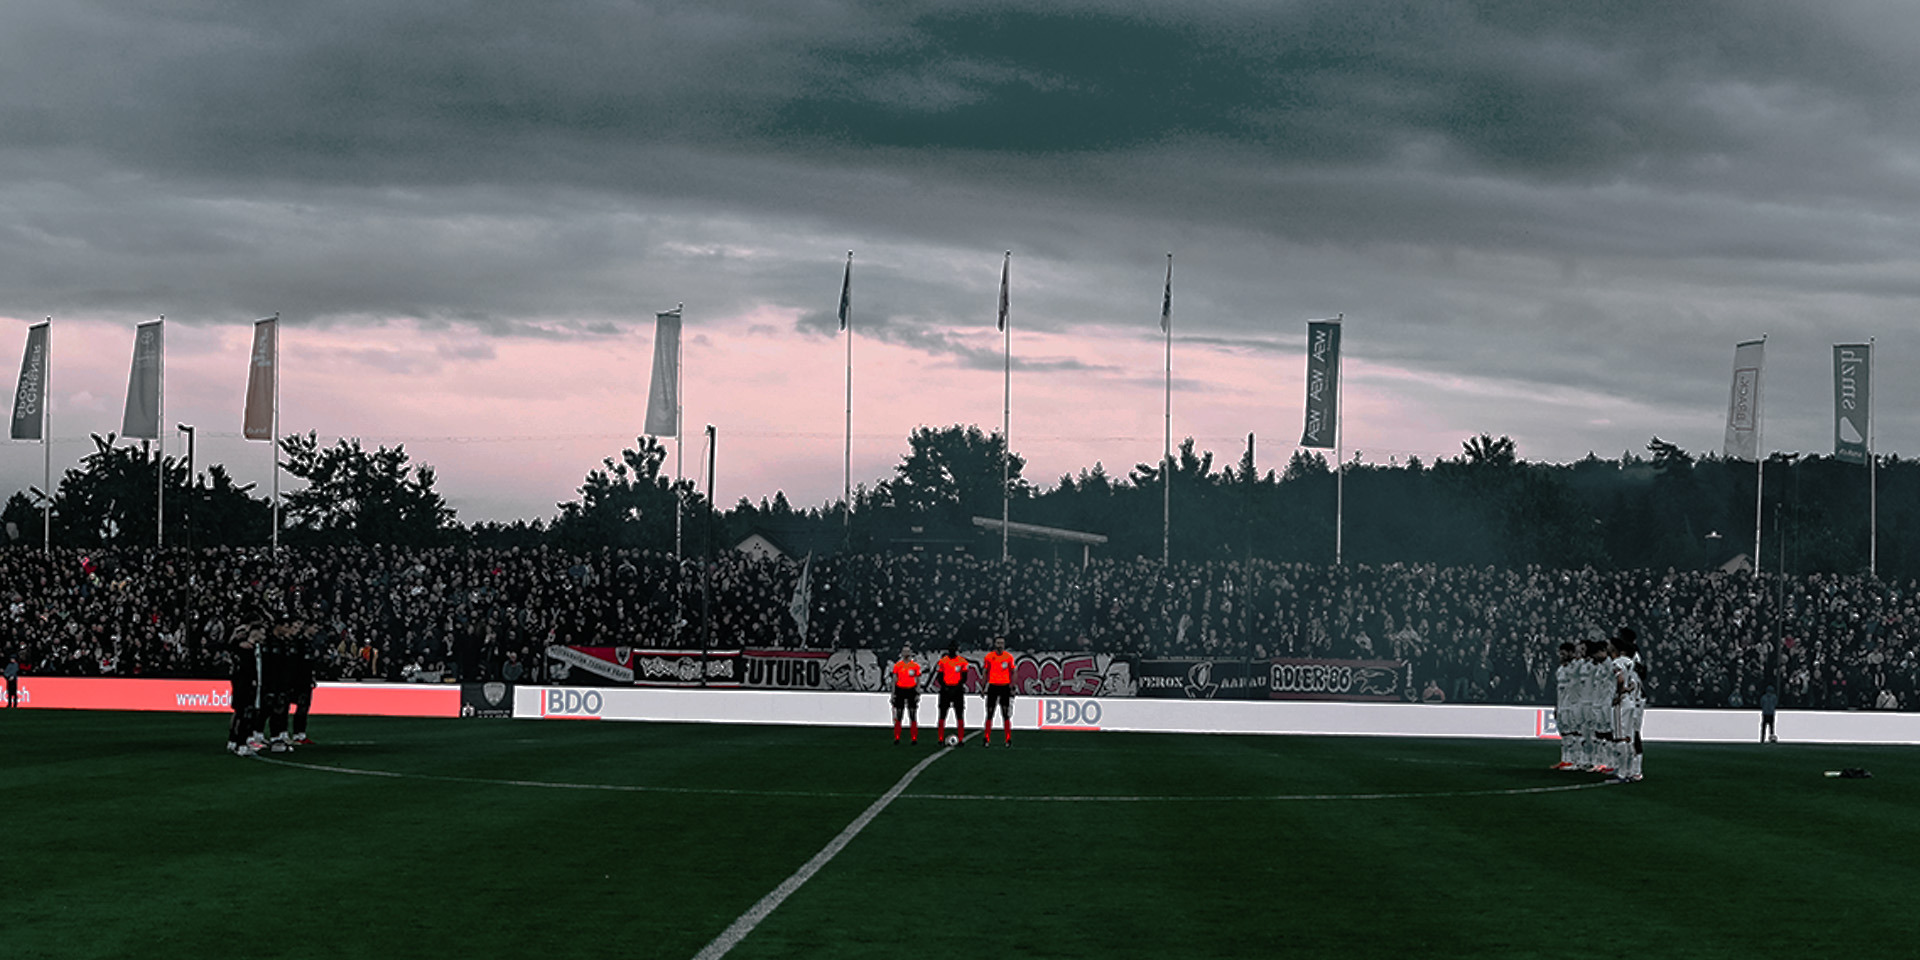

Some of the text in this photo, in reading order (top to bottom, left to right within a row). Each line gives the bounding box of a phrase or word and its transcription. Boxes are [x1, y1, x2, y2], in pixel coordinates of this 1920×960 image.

[1312, 330, 1327, 362] AEW
[1309, 369, 1324, 402] AEW
[1307, 409, 1321, 442] AEW
[741, 658, 820, 687] FUTURO
[1138, 676, 1184, 689] FEROX
[547, 689, 604, 715] BDO
[1046, 699, 1102, 725] BDO
